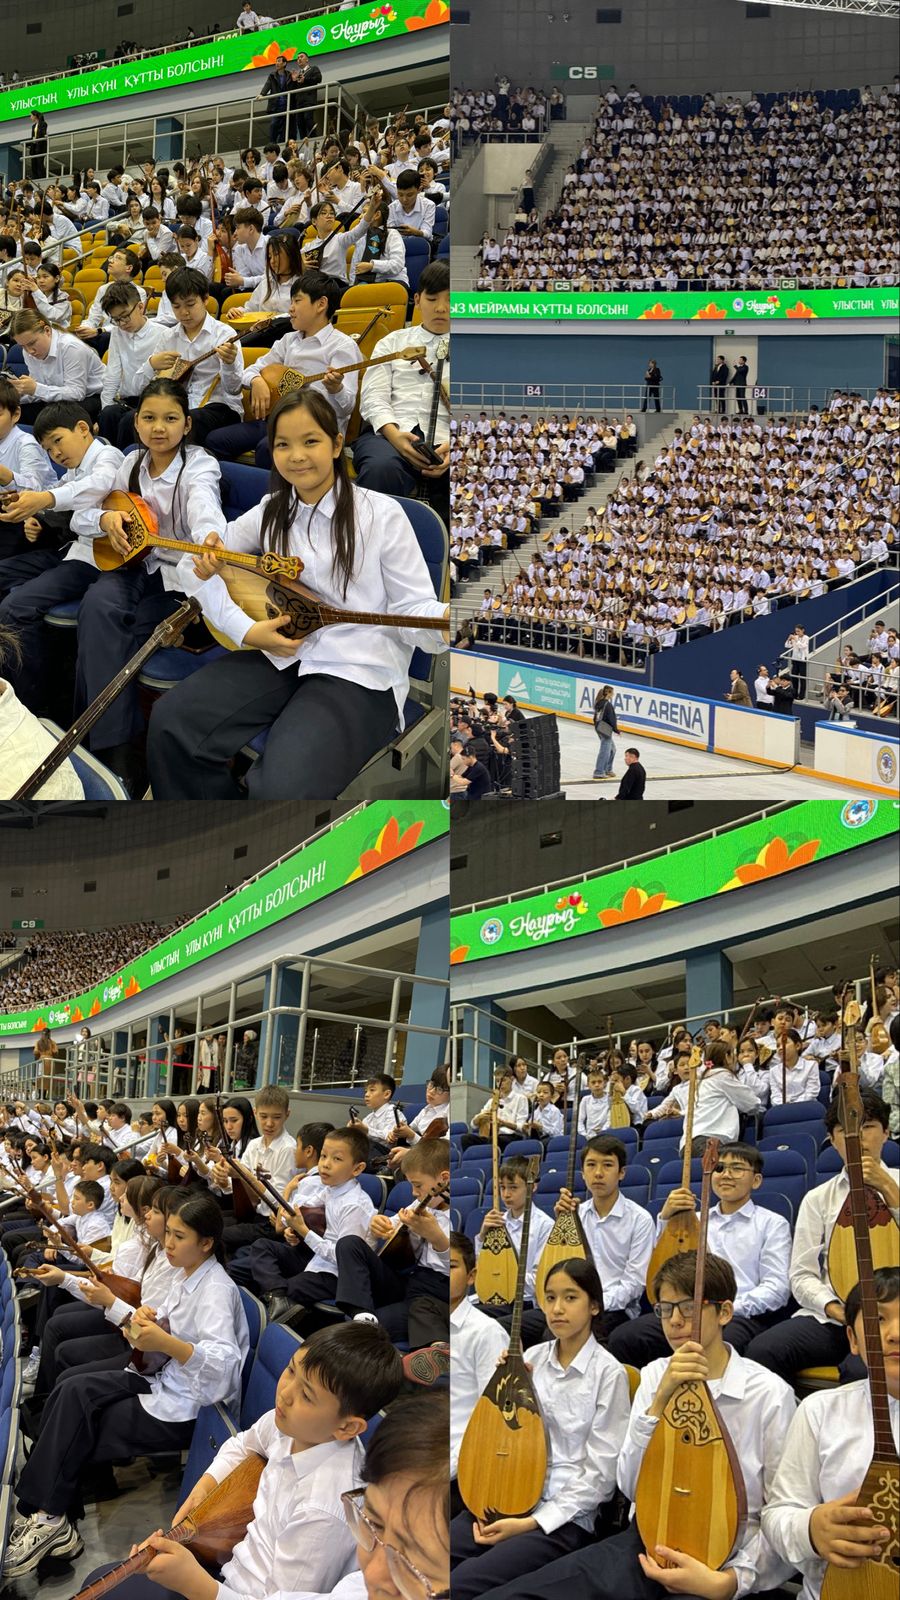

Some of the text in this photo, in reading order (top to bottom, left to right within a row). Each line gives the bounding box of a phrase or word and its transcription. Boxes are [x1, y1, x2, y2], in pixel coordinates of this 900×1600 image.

[331, 17, 390, 42] Наурыз
[67, 86, 89, 100] ҰЛЫ
[167, 55, 224, 78] БОЛСЫН!
[569, 66, 597, 79] C5
[555, 282, 570, 290] C5
[468, 301, 529, 314] МЕЙРАМЫ
[533, 303, 572, 316] ҚҰТТЫ
[576, 303, 628, 315] БОЛСЫН!
[527, 386, 541, 396] B4
[754, 388, 766, 398] B4
[647, 699, 705, 734] ARENA
[265, 860, 327, 912] БОЛСЫН!
[509, 908, 581, 941] Наурыз
